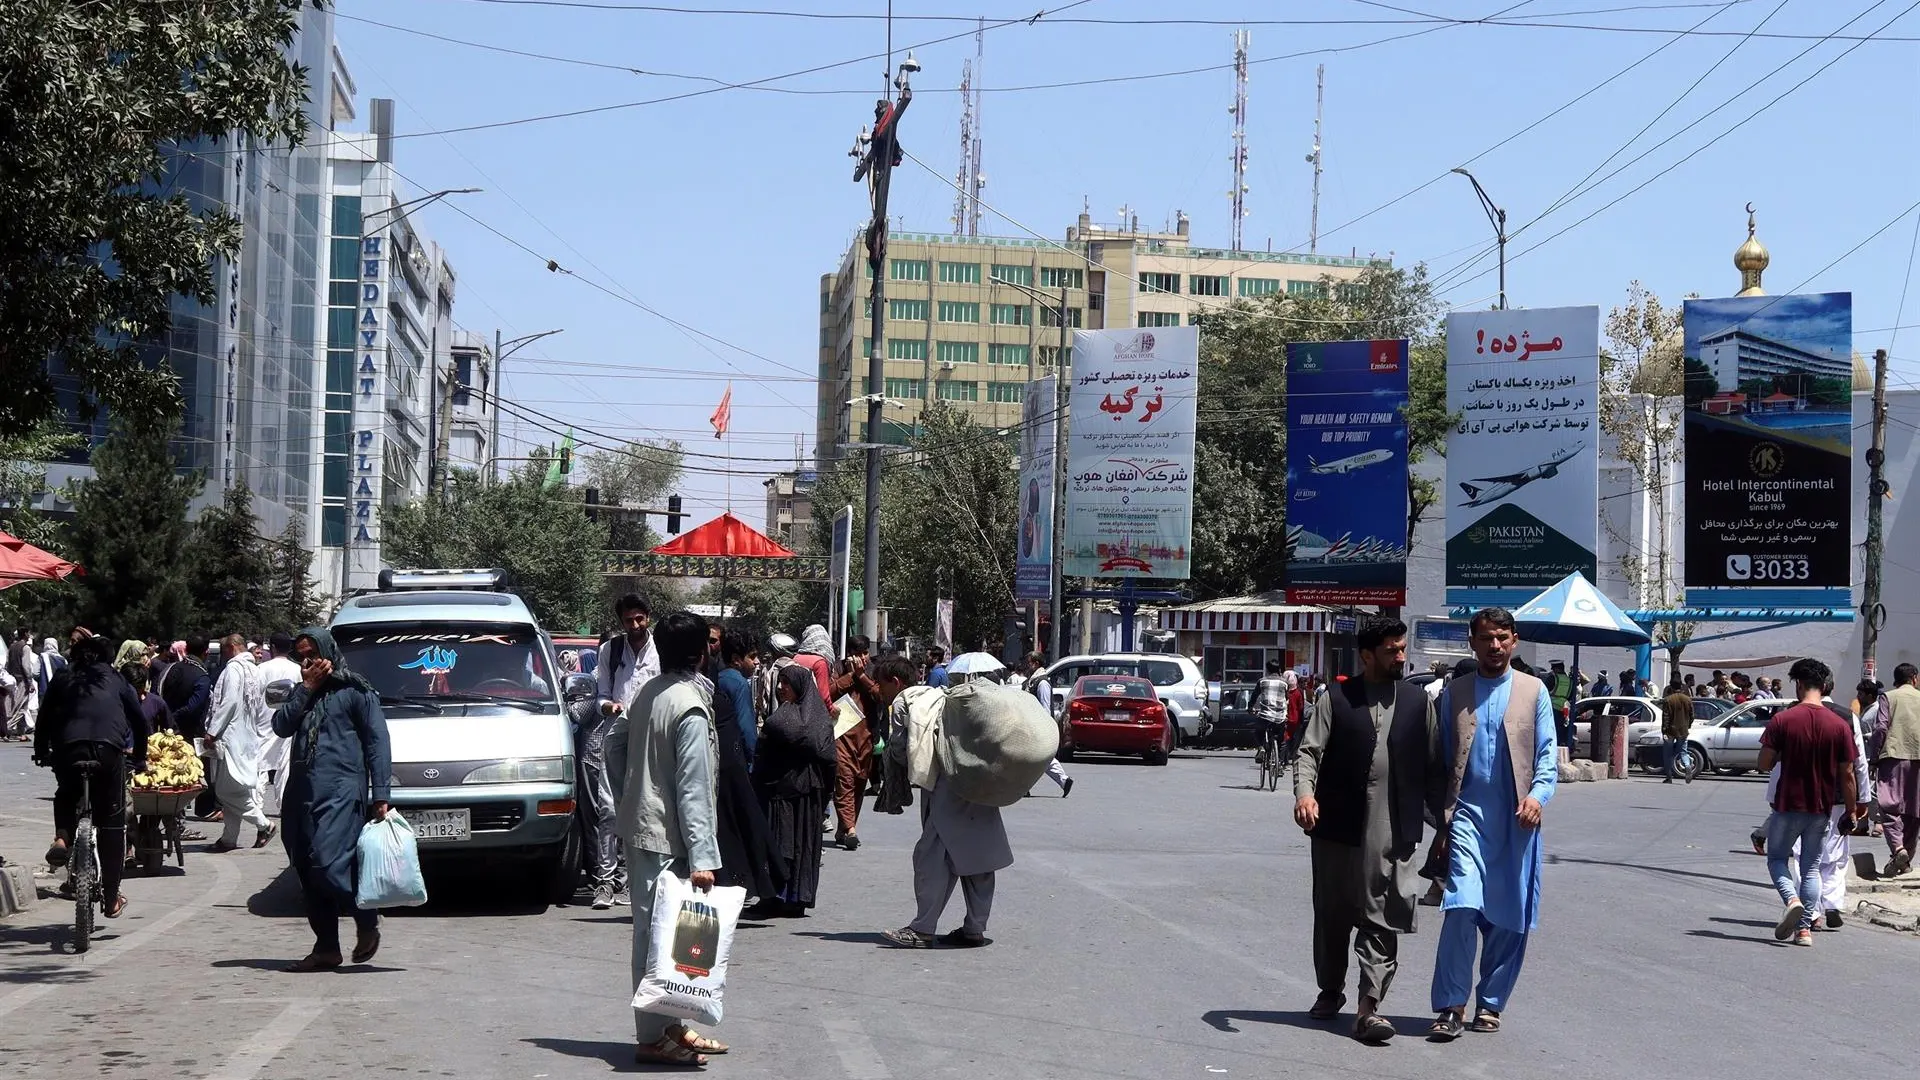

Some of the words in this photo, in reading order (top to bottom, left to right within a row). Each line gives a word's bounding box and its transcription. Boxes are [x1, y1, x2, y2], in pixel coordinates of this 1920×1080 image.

[360, 237, 381, 396] HEDAYAT
[1370, 363, 1398, 371] Emirates
[1079, 372, 1101, 385] کشور
[1102, 369, 1136, 385] تحصیلی
[1158, 368, 1191, 380] خدمات
[1503, 377, 1532, 390] یکساله
[1557, 375, 1576, 386] اخذ
[1099, 385, 1164, 423] ترکیه
[1496, 399, 1503, 411] با
[1506, 401, 1522, 412] روز
[1524, 398, 1539, 412] یک
[1573, 398, 1585, 411] در
[1300, 414, 1314, 425] YOUR
[1314, 413, 1334, 424] HEALTH
[1335, 413, 1347, 424] AND
[1349, 412, 1371, 424] SAFETY
[1370, 412, 1393, 424] REMAIN
[1563, 417, 1589, 431] توسط
[1532, 418, 1560, 432] شرکت
[1321, 431, 1334, 442] OUR
[1333, 431, 1345, 442] TOP
[1344, 431, 1371, 442] PRIORITY
[1551, 448, 1566, 460] PIA
[1073, 472, 1102, 486] هوپ
[1105, 468, 1138, 483] افغان
[1146, 467, 1188, 484] شرکت
[355, 430, 373, 542] PLAZA
[1703, 479, 1734, 491] Hotel
[1737, 478, 1835, 490] Intercontinental
[1748, 491, 1783, 503] Kabul
[1749, 503, 1769, 511] since
[1770, 503, 1786, 511] 1969
[1700, 519, 1726, 531] محافل
[1727, 517, 1763, 531] برگذاری
[1764, 518, 1784, 530] برای
[1785, 518, 1807, 530] مکان
[1808, 518, 1839, 530] بهترین
[1488, 526, 1545, 538] PAKISTAN
[1720, 532, 1737, 542] شما
[1766, 532, 1781, 543] غیر
[1489, 537, 1523, 545] International
[1738, 534, 1764, 544] رسمی
[1783, 535, 1789, 543] و
[1790, 534, 1817, 543] رسمی
[1753, 560, 1810, 580] 3033
[397, 645, 459, 670] الله
[419, 824, 454, 837] 51182
